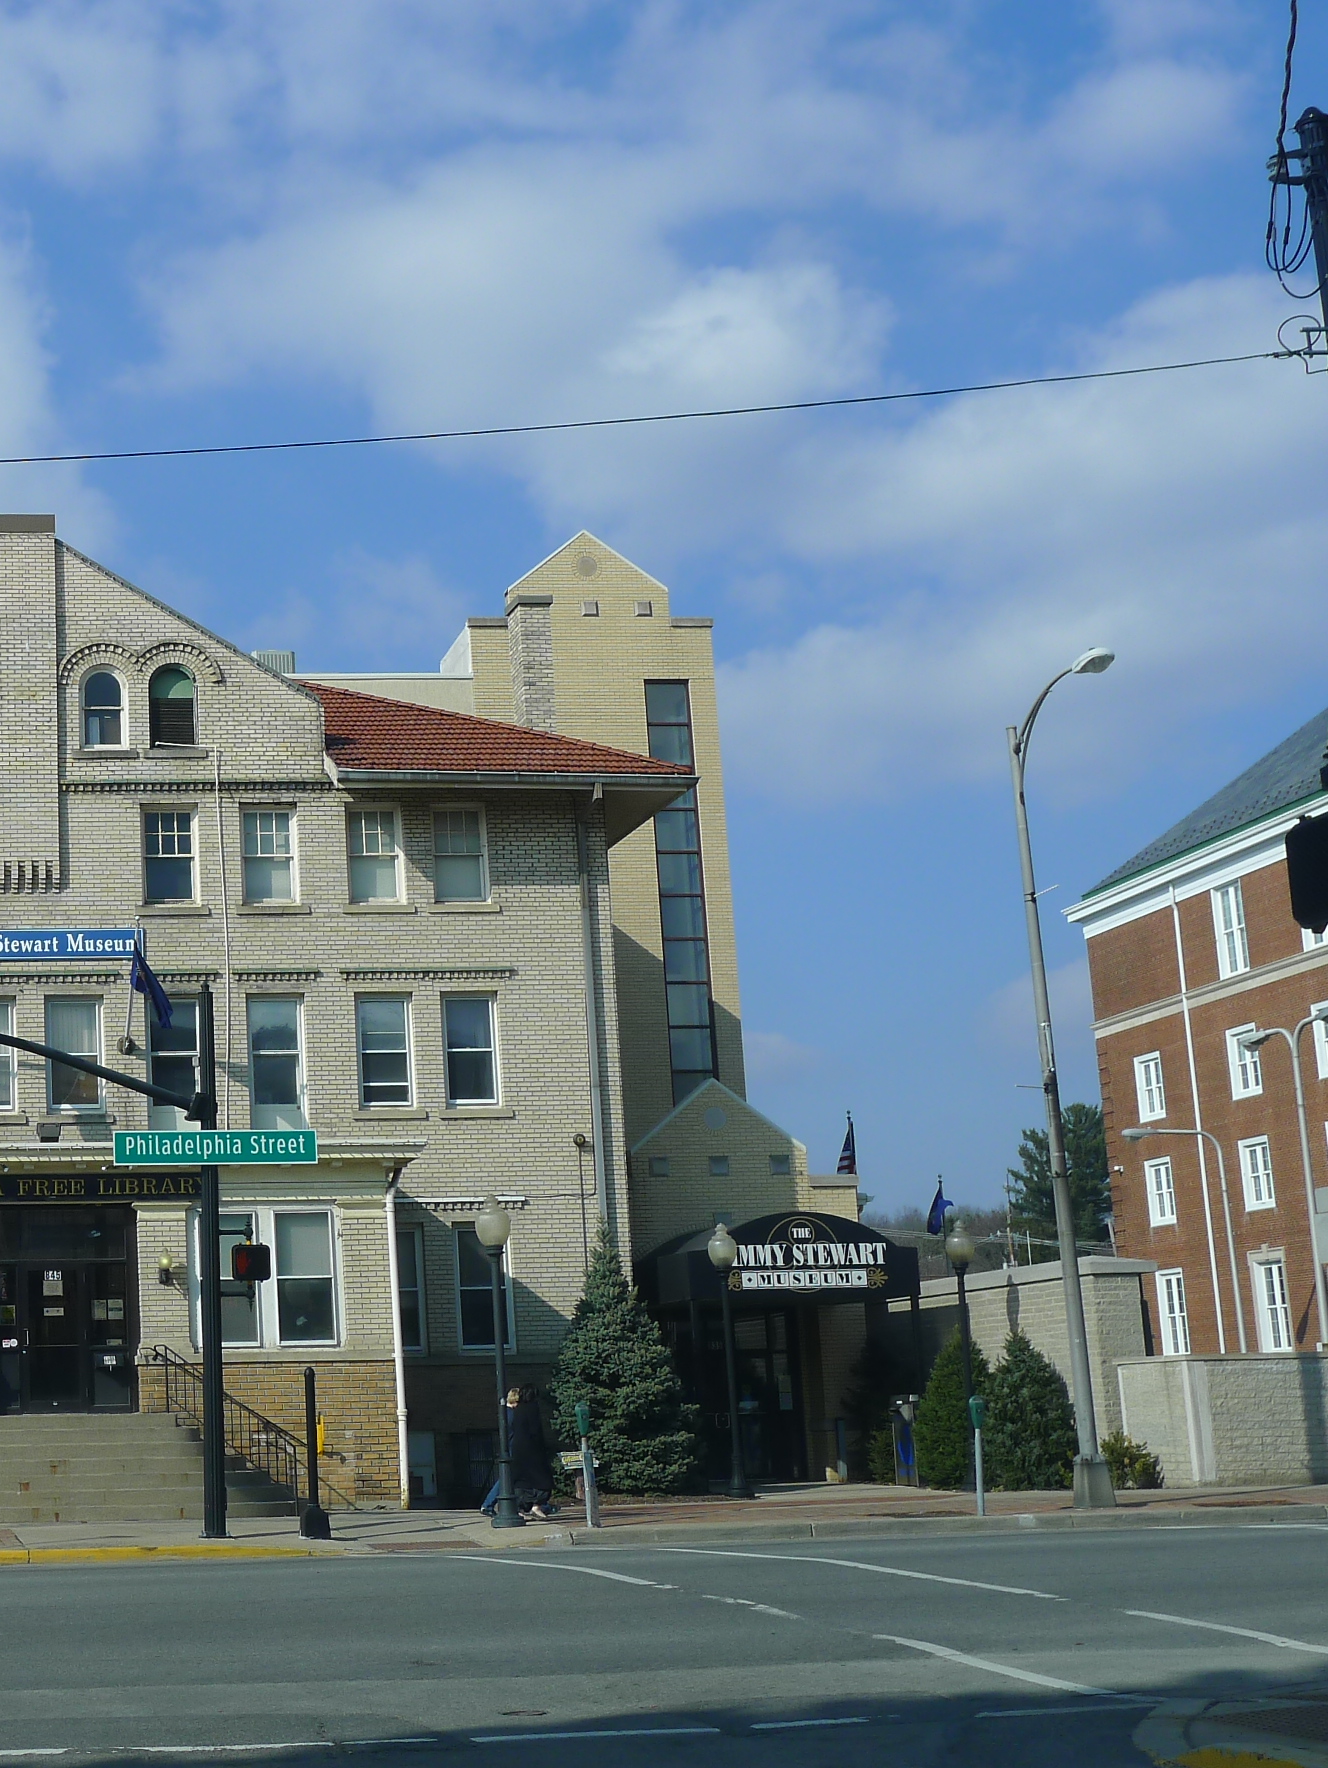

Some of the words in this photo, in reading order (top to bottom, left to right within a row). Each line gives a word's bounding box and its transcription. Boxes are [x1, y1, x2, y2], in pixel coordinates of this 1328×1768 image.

[125, 1134, 243, 1160] Philadelphia
[249, 1134, 307, 1155] Street
[17, 1178, 86, 1196] FREE
[791, 1227, 812, 1239] THE
[792, 1242, 887, 1266] STEWART
[759, 1272, 852, 1286] MUSEUM
